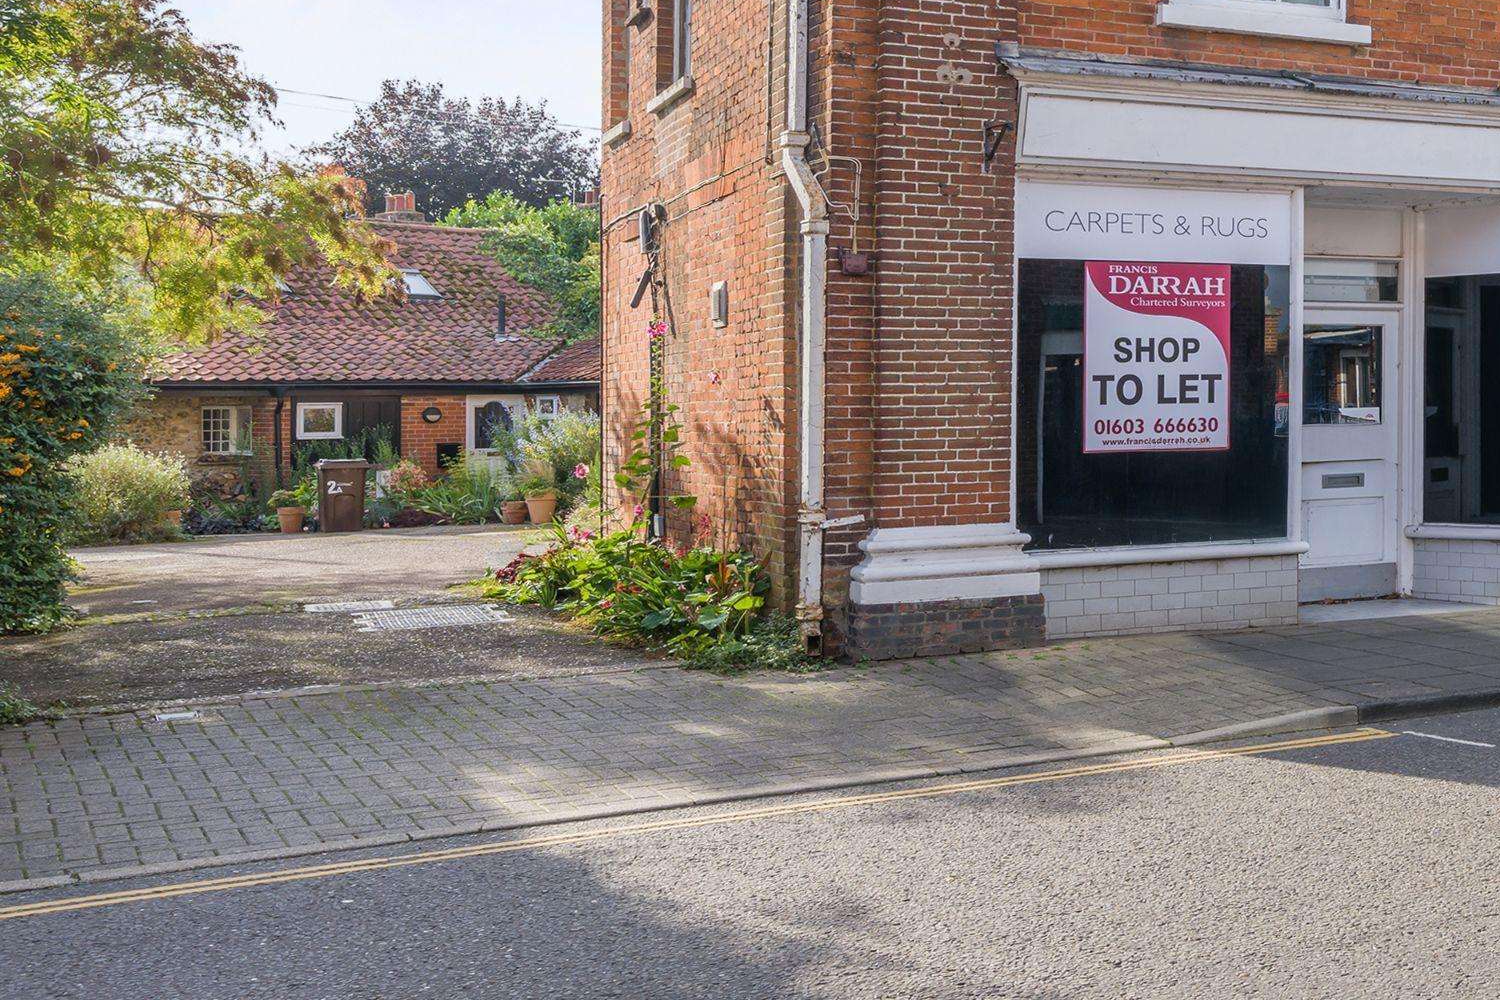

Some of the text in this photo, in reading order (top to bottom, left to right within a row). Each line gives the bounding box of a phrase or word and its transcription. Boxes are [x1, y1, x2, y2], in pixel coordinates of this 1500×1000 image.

[1045, 210, 1269, 239] CARPETS & RUGS
[1109, 265, 1158, 274] FRANCIS
[1108, 275, 1226, 296] DARRAH
[1130, 297, 1226, 309] Chartered Surveyors
[1114, 337, 1200, 363] SHOP
[1092, 373, 1222, 405] TO LET
[1094, 417, 1219, 435] 01603 666630
[1102, 436, 1211, 446] www.francisdarrah.co.uk
